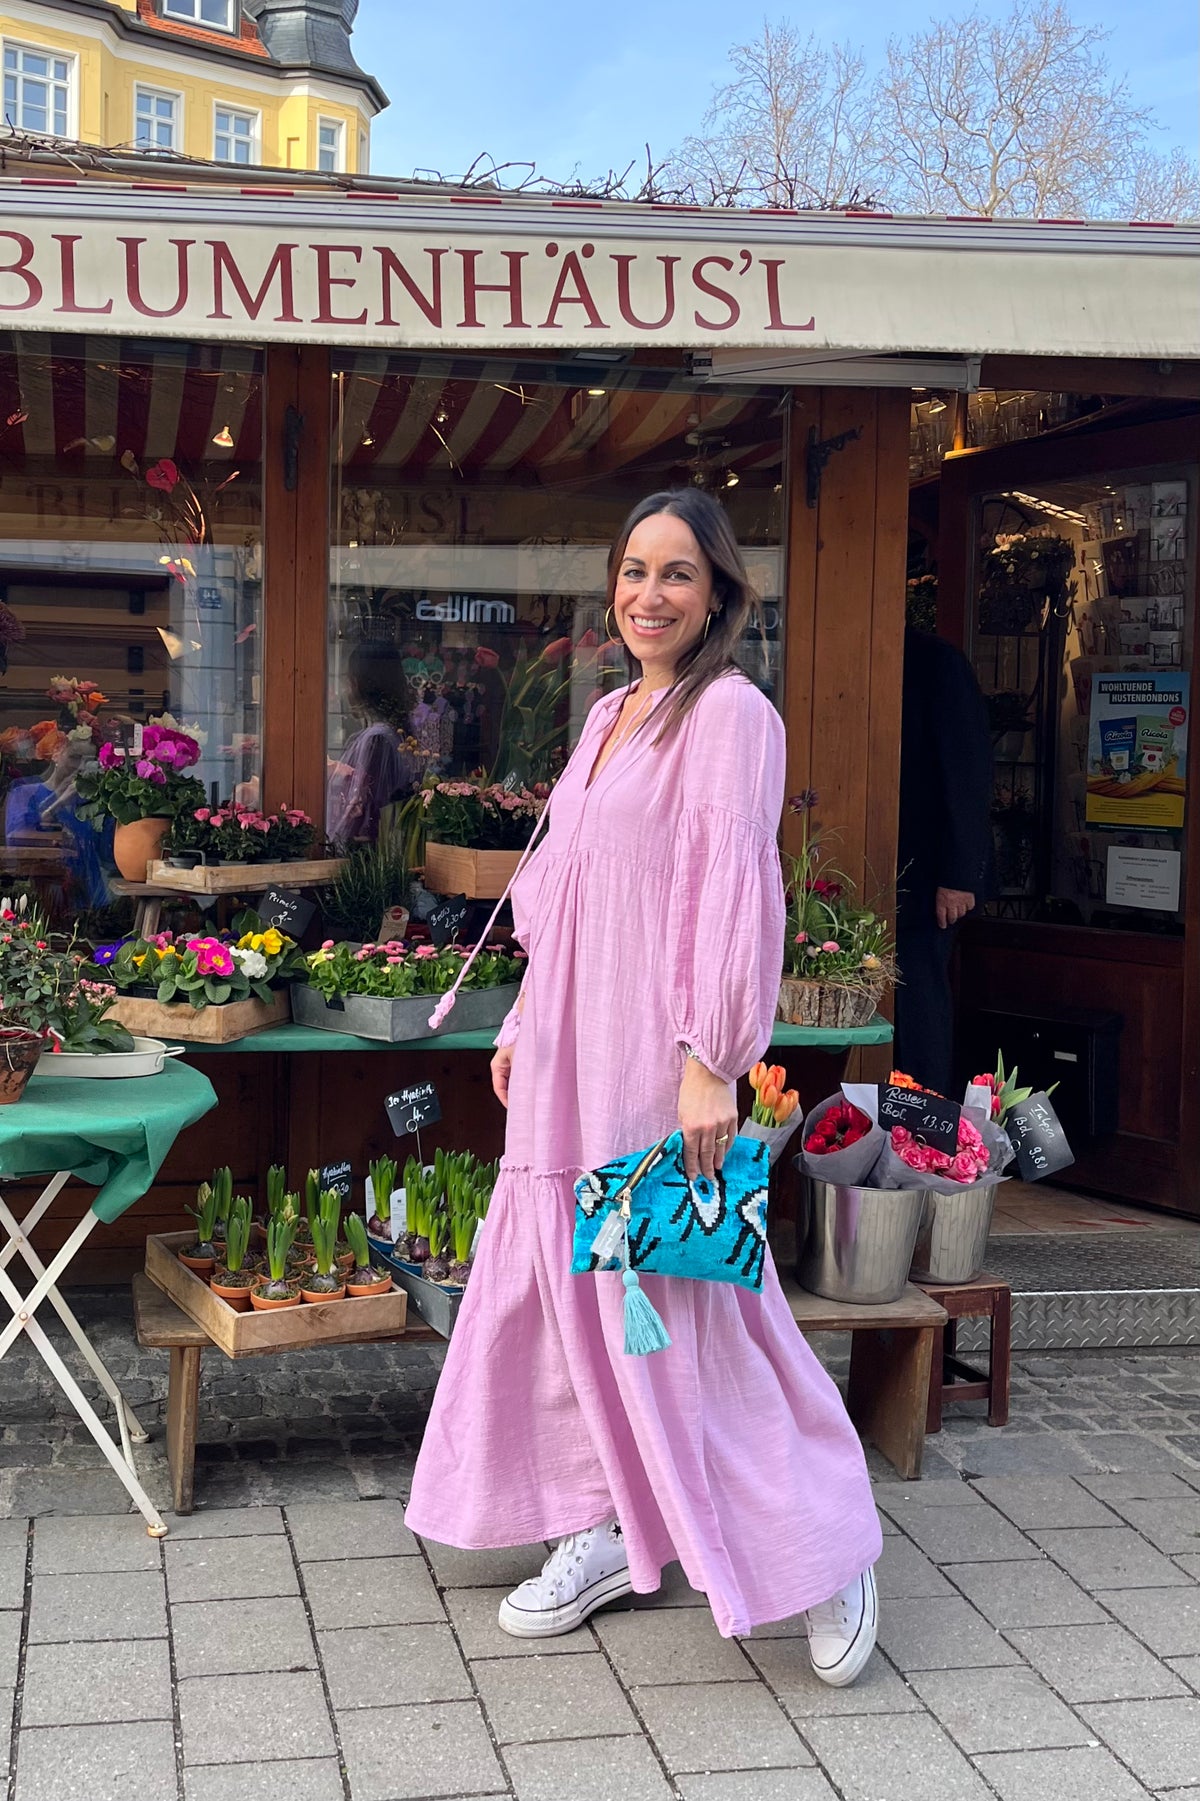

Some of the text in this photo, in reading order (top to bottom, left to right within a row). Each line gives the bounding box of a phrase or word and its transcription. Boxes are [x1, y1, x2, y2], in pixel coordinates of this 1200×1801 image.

[1101, 682, 1153, 692] WOHLTUENDE
[1111, 693, 1180, 703] HUSTENBONBONS
[1105, 730, 1132, 741] Ricola
[1141, 728, 1168, 739] Ricola
[885, 1086, 928, 1107] Rosen
[1034, 1103, 1056, 1139] Tulpen
